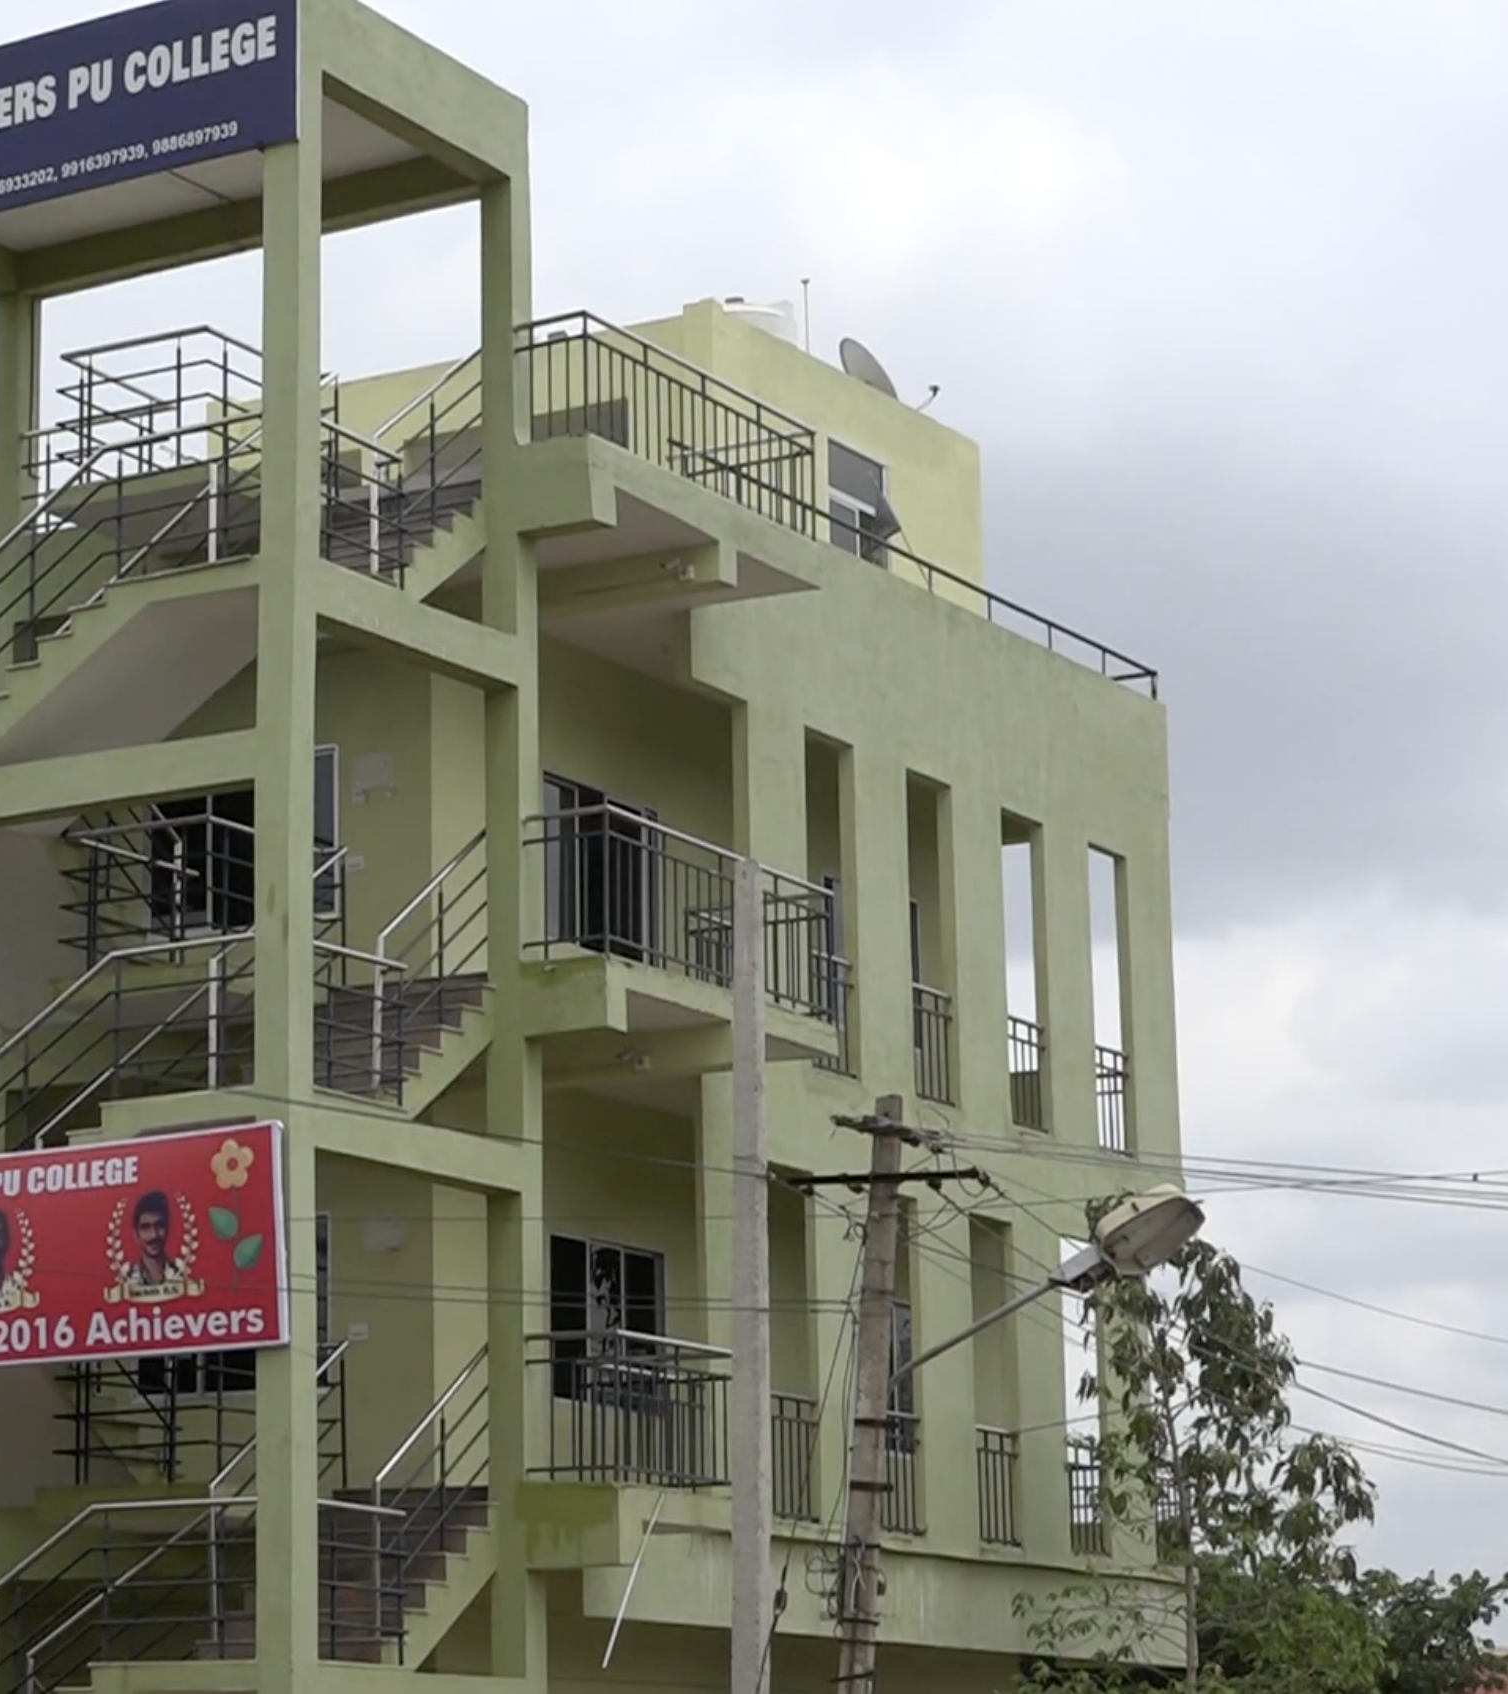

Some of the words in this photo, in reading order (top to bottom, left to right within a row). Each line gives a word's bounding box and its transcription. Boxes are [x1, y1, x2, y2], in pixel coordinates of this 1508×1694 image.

[67, 59, 113, 110] PU
[123, 15, 277, 95] COLLEGE
[152, 120, 239, 155] 9886897939
[27, 1155, 139, 1195] COLLEGE
[85, 1306, 265, 1347] Achievers
